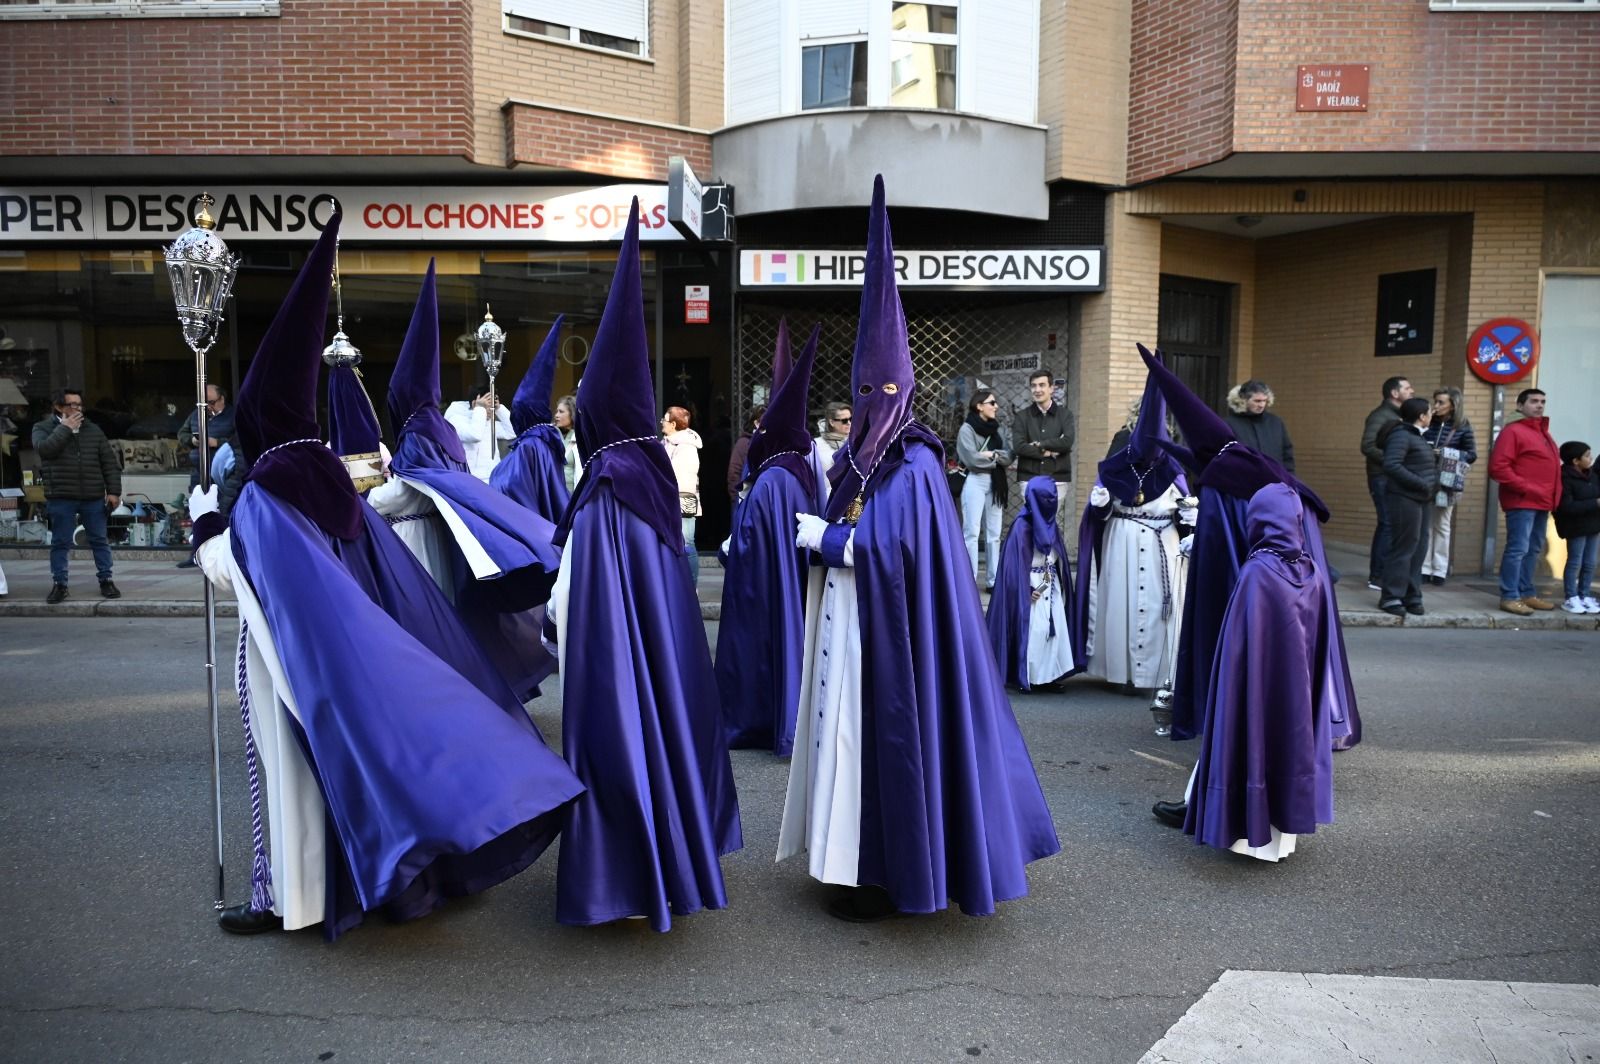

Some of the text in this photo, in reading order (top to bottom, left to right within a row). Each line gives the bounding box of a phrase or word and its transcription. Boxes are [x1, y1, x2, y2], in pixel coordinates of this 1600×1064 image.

[1316, 80, 1341, 93] DAOÍZ
[1316, 96, 1360, 107] Y VELARDE
[105, 193, 343, 233] DESCANSO
[363, 203, 545, 229] COLCHONES
[814, 254, 1090, 281] HIPR DESCANSO
